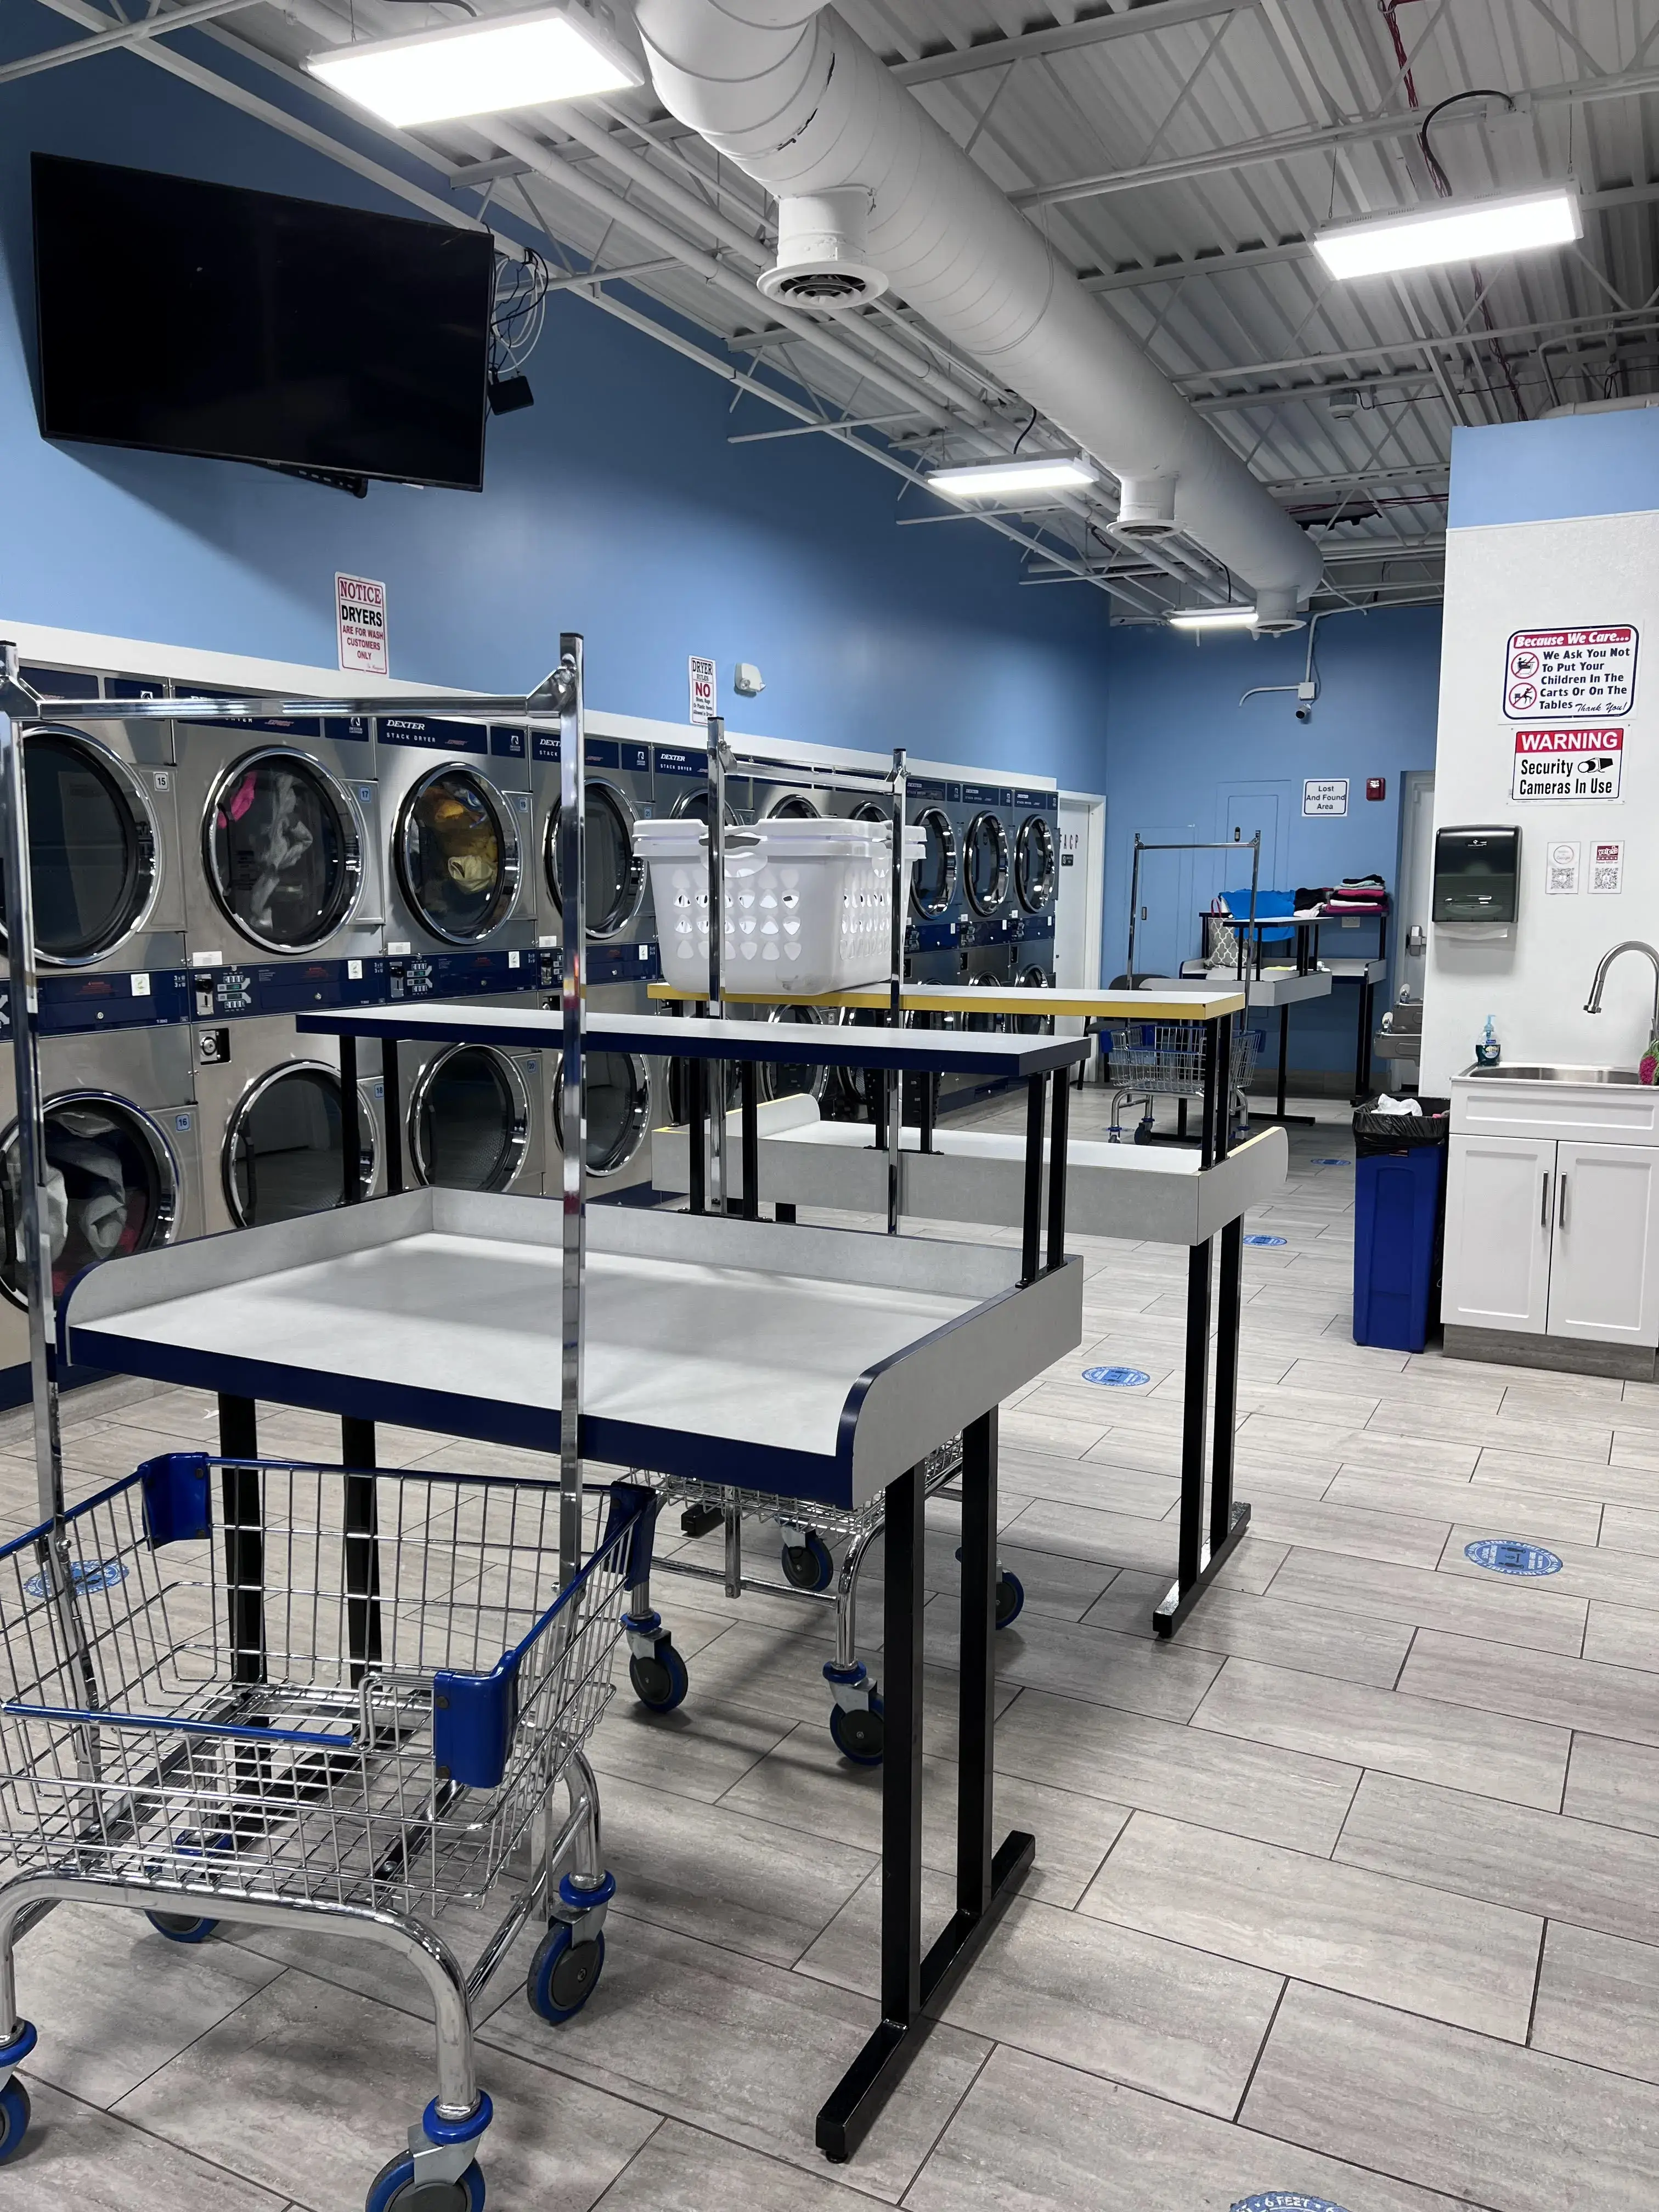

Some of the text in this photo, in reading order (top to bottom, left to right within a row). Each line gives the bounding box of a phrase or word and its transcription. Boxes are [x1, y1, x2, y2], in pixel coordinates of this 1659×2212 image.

[340, 580, 381, 604] NOTICE
[341, 605, 382, 627] DRYERS
[342, 625, 384, 640] ARE FOR WASH
[1516, 631, 1629, 647] Because We Care...
[347, 637, 380, 651] CUSTOMERS
[357, 650, 372, 660] ONLY
[1543, 648, 1630, 660] We Ask You Not
[692, 661, 712, 675] DRYER
[1542, 662, 1604, 673] To Put Your
[1541, 674, 1624, 685] Children In The
[696, 681, 710, 698] NO
[1540, 686, 1627, 697] Carts Or On The
[1539, 701, 1628, 713] Tables Thank You!
[386, 719, 425, 730] DEXTER
[540, 738, 561, 747] DEXT
[1521, 731, 1618, 751] WARNING
[661, 753, 685, 761] DEXTER
[1521, 759, 1573, 777] Security
[1520, 778, 1612, 795] Cameras In Use
[1265, 2197, 1310, 2208] 6 FEET
